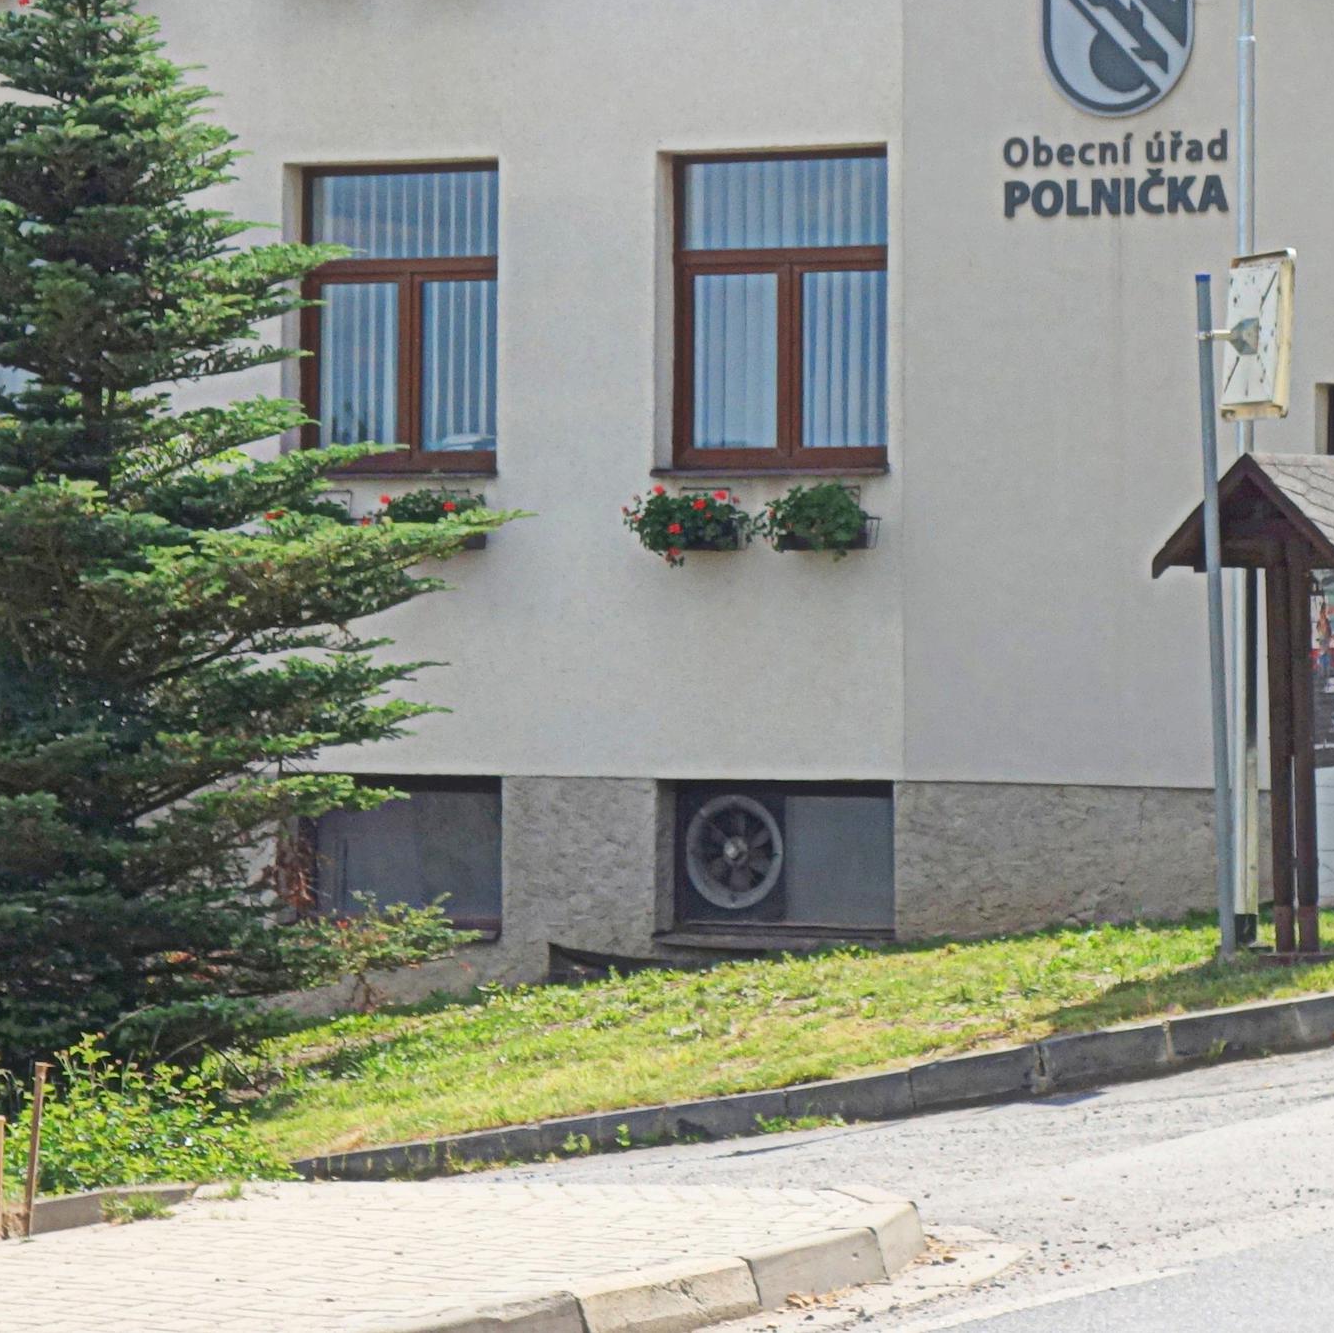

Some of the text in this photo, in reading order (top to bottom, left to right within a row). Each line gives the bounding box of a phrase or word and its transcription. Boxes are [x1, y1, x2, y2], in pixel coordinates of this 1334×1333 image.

[1003, 128, 1228, 168] Obecní úřad
[1004, 168, 1229, 219] POLNIČKA
